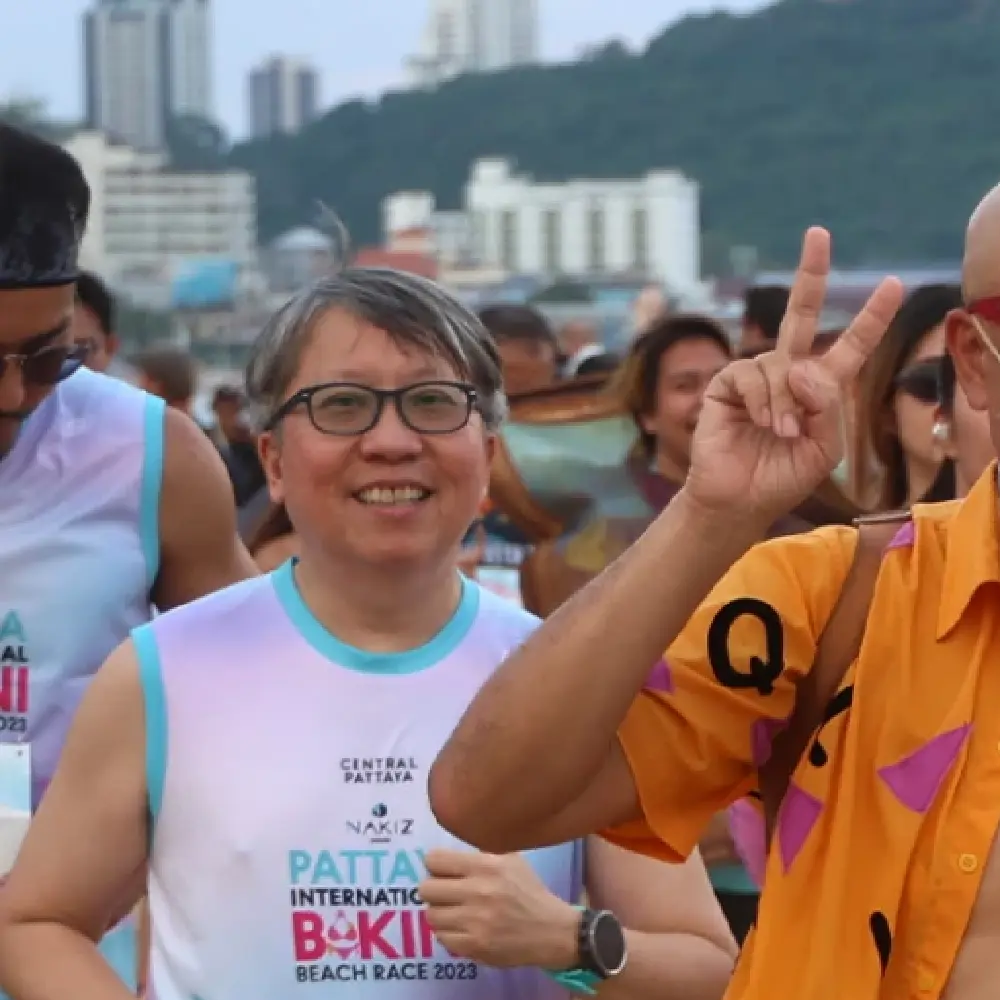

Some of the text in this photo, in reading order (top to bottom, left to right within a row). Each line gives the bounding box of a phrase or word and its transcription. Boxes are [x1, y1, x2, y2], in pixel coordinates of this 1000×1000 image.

[707, 597, 783, 695] Q
[0, 716, 27, 731] 023
[340, 757, 418, 770] CENTRAL
[344, 771, 414, 783] PATTAYA
[289, 848, 428, 884] PATTA
[296, 962, 478, 982] BEACH RACE 2023
